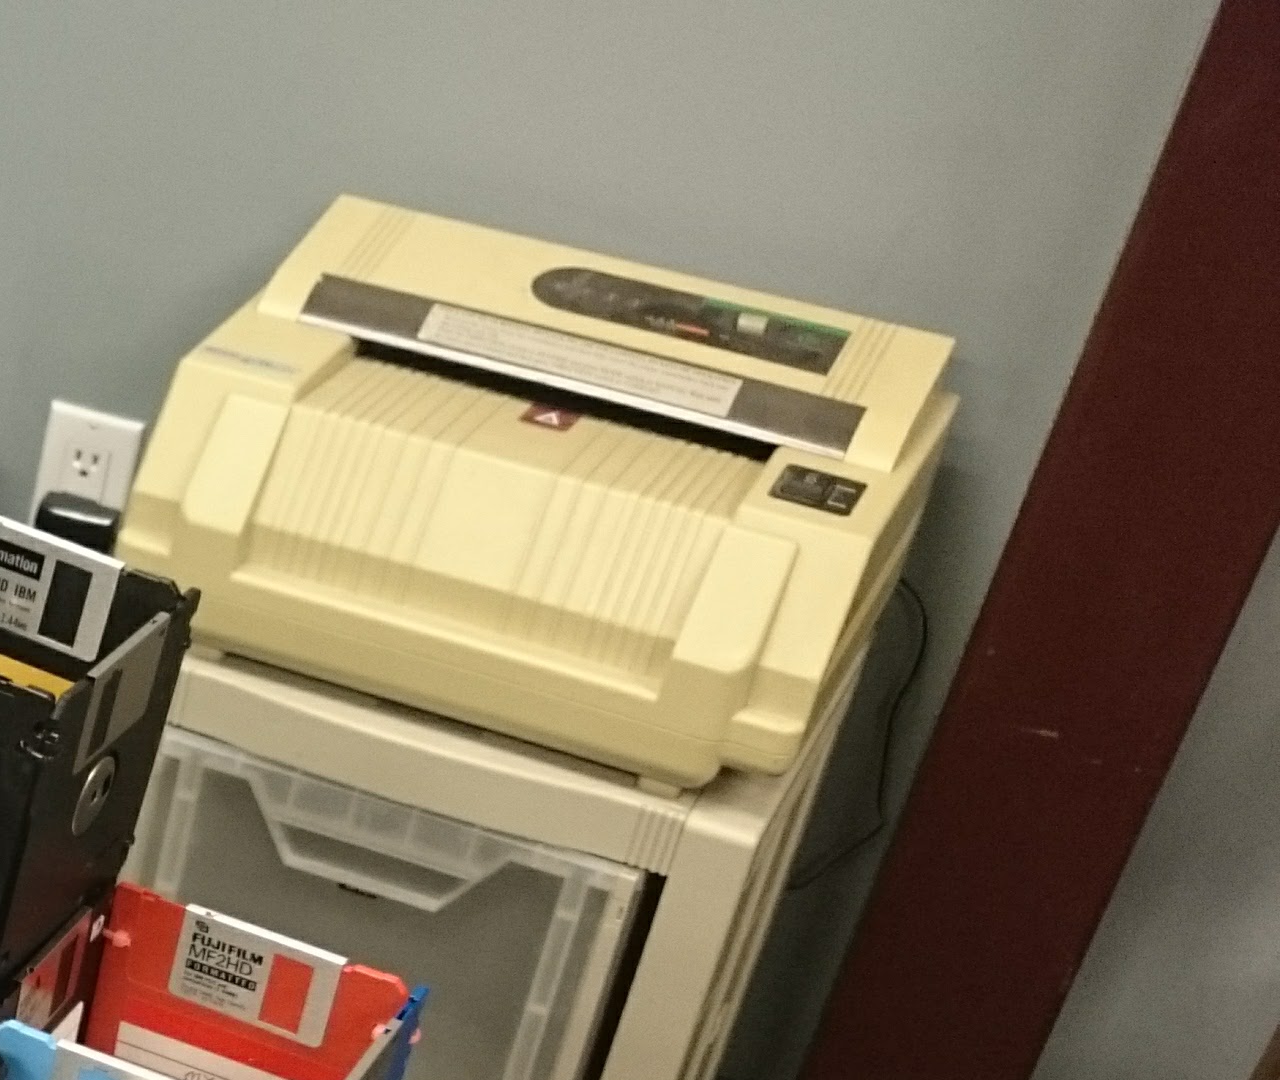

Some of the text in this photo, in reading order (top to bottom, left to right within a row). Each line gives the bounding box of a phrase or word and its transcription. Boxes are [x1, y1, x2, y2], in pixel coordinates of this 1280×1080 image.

[14, 583, 38, 603] IBM
[188, 943, 253, 976] MF2HD
[191, 931, 264, 966] FUJIFILM
[186, 959, 257, 991] FORMATTED
